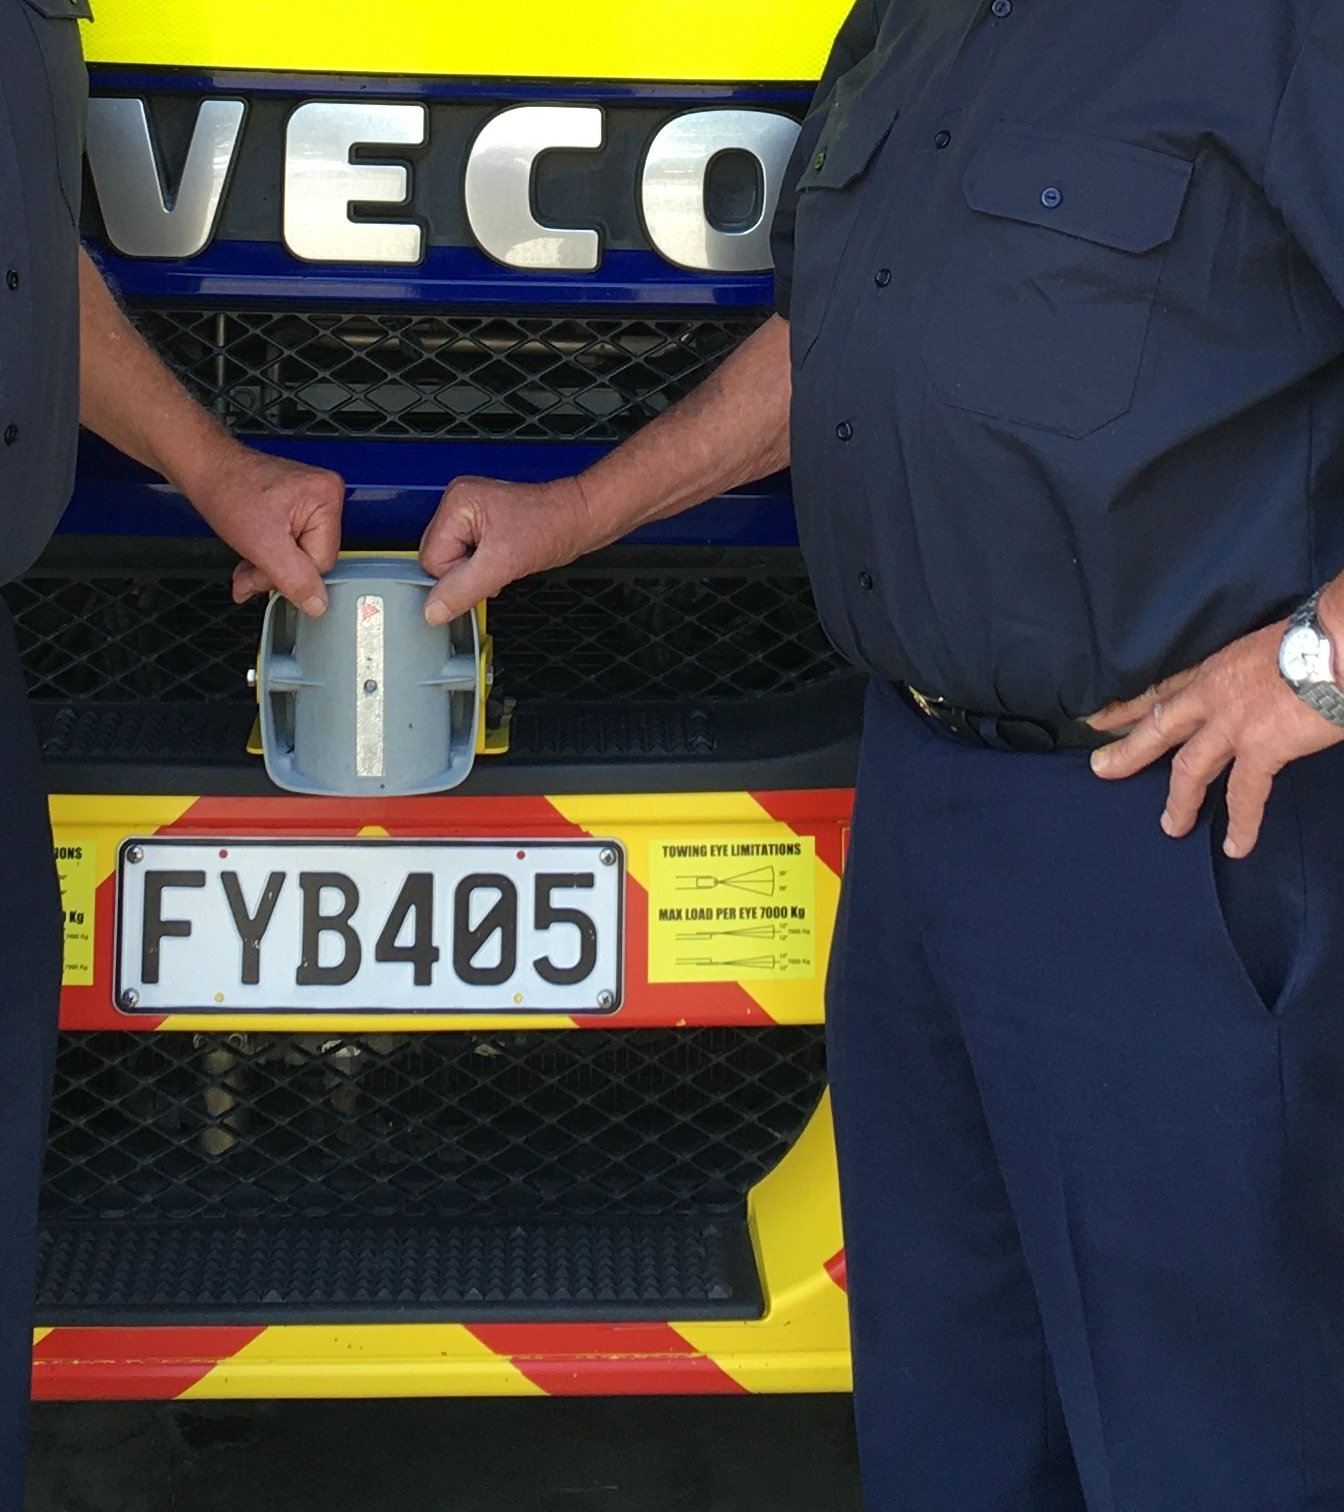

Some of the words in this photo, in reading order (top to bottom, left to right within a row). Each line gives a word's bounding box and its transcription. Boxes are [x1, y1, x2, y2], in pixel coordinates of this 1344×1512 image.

[86, 97, 802, 272] VECO
[662, 845, 707, 858] TOWING
[710, 844, 728, 857] EYE
[731, 843, 801, 856] LIMITATIONS
[69, 911, 84, 924] Kg
[658, 908, 683, 921] MAX
[685, 908, 713, 920] LOAD
[716, 907, 736, 920] PER
[739, 907, 758, 920] EYE
[760, 907, 787, 919] 7000
[790, 907, 805, 920] Kg
[141, 870, 597, 987] FYB405
